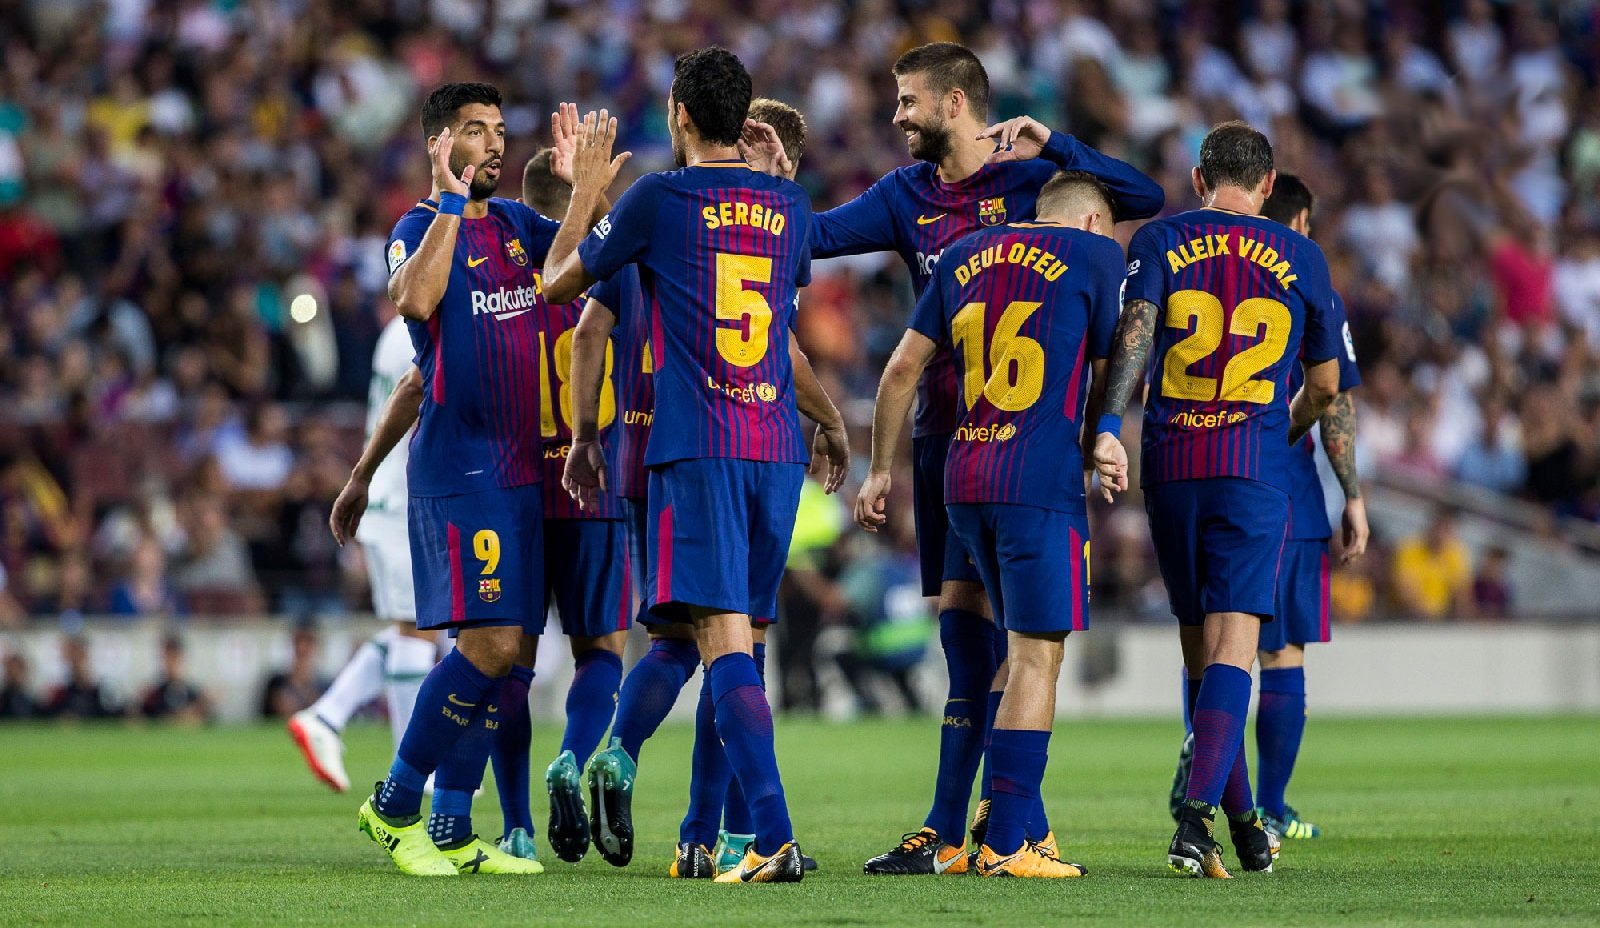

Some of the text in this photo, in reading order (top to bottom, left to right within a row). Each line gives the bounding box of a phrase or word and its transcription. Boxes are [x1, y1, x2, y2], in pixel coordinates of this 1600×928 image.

[702, 202, 785, 236] SERGIO
[954, 242, 1069, 287] DEULOFEU
[1166, 233, 1298, 290] ALEIX VIDAL
[715, 252, 773, 368] 5
[951, 301, 1044, 412] 16
[1161, 289, 1292, 405] 22
[473, 529, 501, 575] 9
